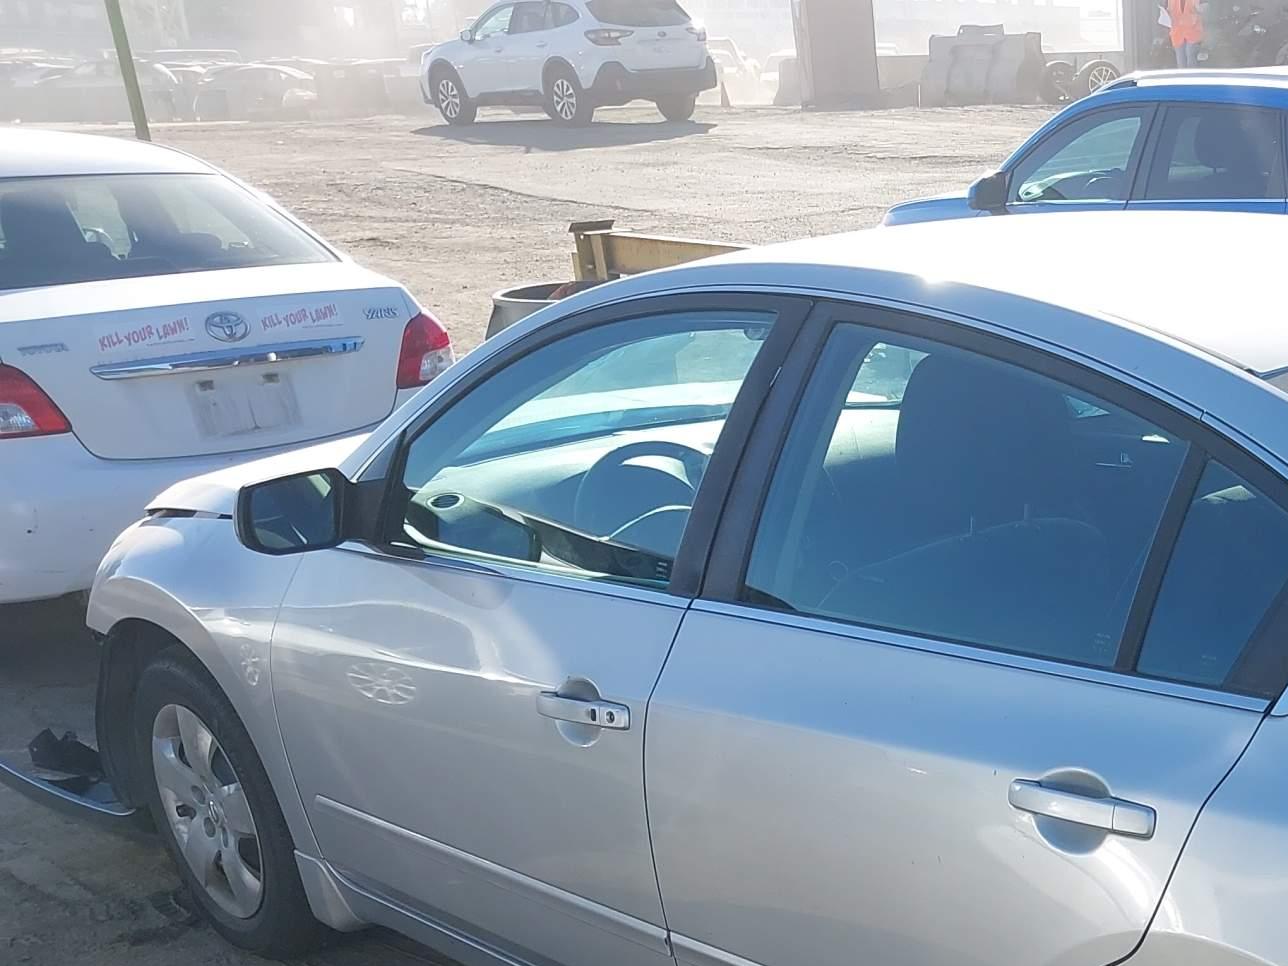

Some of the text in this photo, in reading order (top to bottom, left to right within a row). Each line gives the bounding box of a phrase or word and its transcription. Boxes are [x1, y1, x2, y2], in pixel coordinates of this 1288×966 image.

[261, 303, 338, 331] KILL YOUR LAWN!
[98, 331, 124, 352] KILL
[114, 324, 154, 346] YOUR
[156, 317, 190, 341] LAWN!
